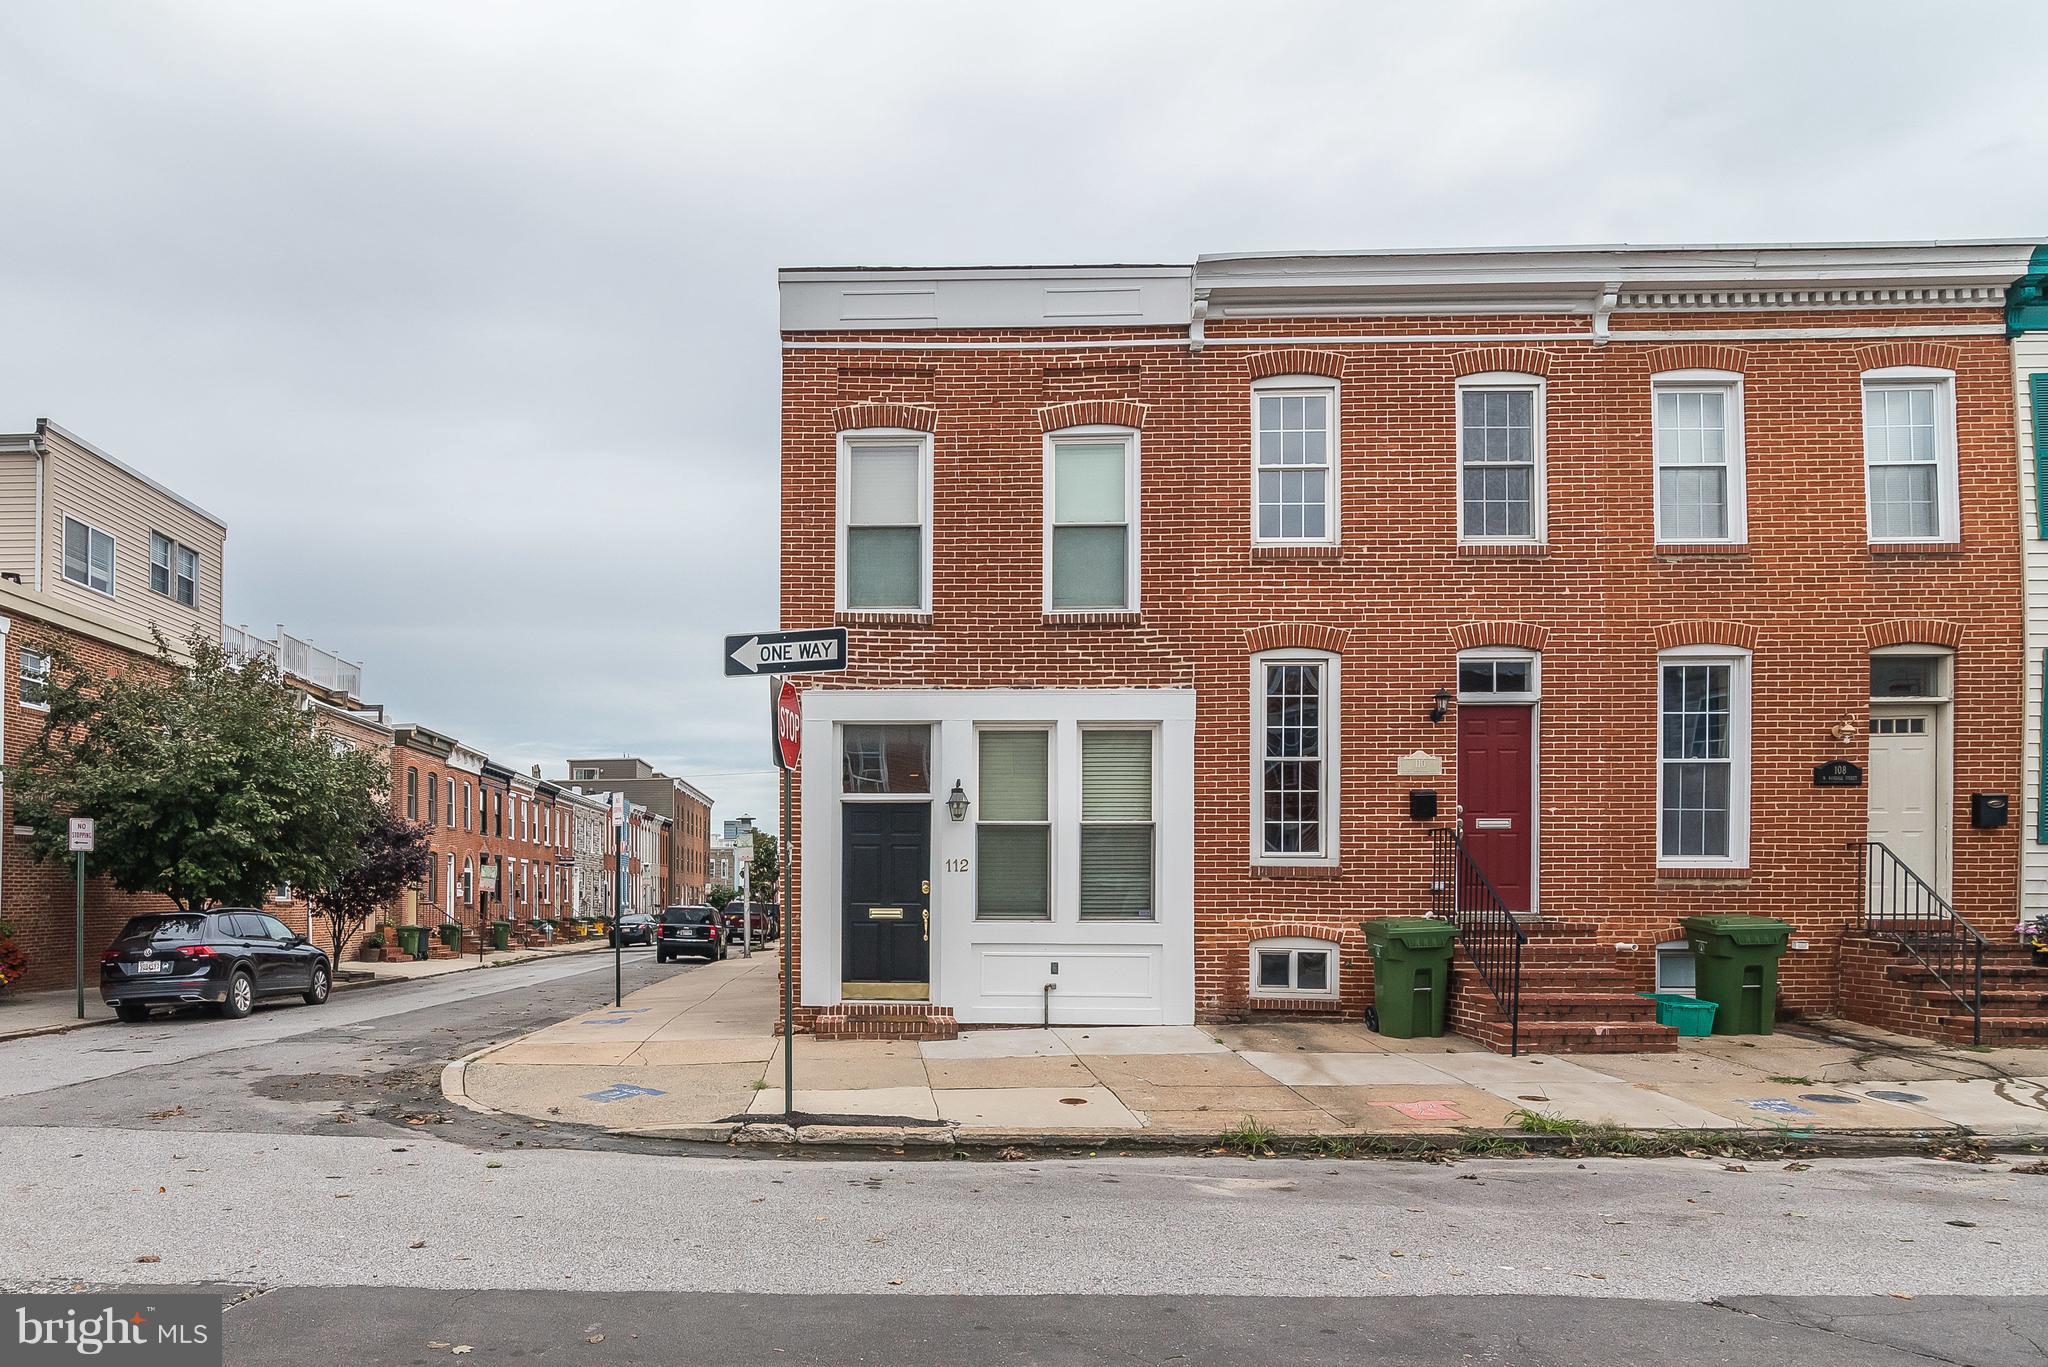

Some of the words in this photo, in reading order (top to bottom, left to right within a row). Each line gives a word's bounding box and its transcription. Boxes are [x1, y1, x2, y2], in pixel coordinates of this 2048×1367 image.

[760, 644, 793, 662] ONE
[798, 641, 833, 660] WAY
[780, 706, 800, 744] STOP
[1415, 759, 1426, 768] 110
[1834, 765, 1847, 775] 108
[71, 831, 92, 839] STOPPING
[945, 858, 969, 873] 112
